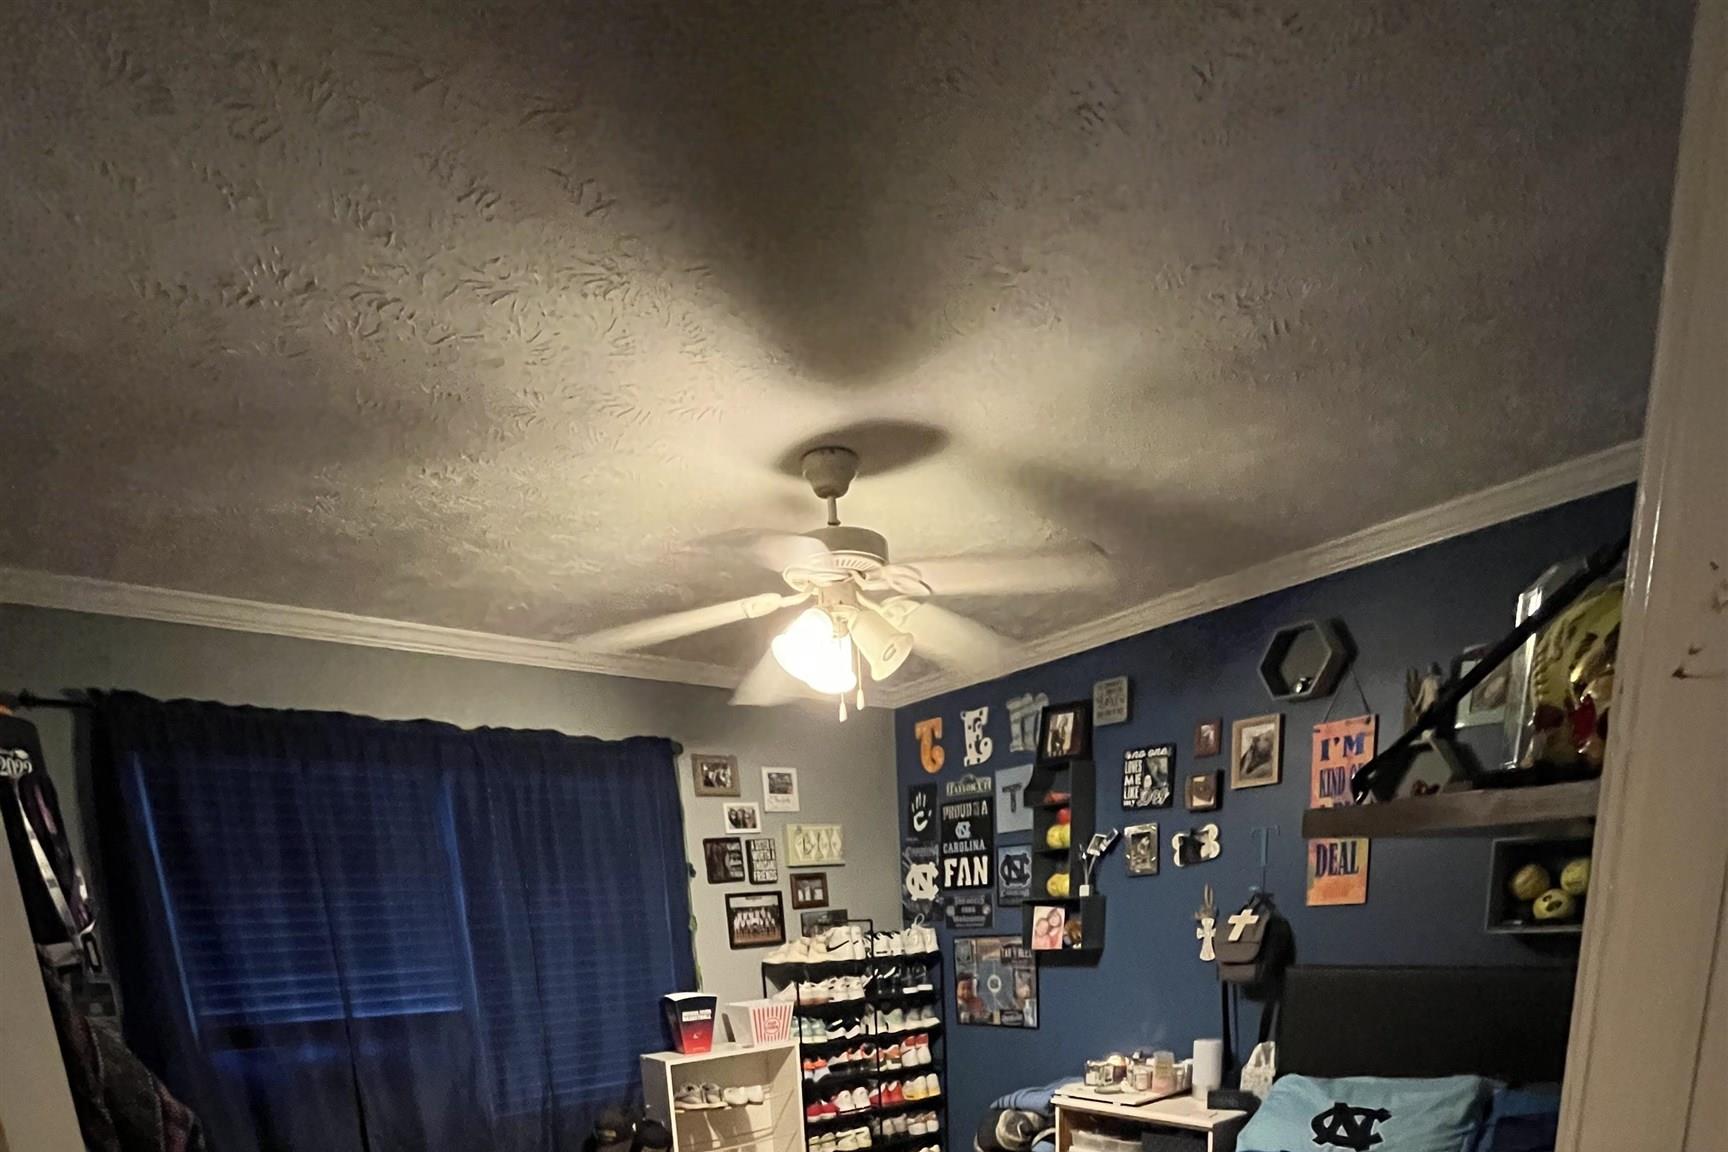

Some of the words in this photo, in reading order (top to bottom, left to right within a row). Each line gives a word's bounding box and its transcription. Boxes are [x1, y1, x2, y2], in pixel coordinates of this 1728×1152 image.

[1320, 732, 1366, 761] I'M
[1124, 773, 1142, 786] ME
[1319, 766, 1346, 798] KIND
[943, 802, 973, 820] PROUD
[943, 839, 985, 854] CAROLINA
[1315, 841, 1360, 878] DEAL
[944, 855, 989, 888] FAN
